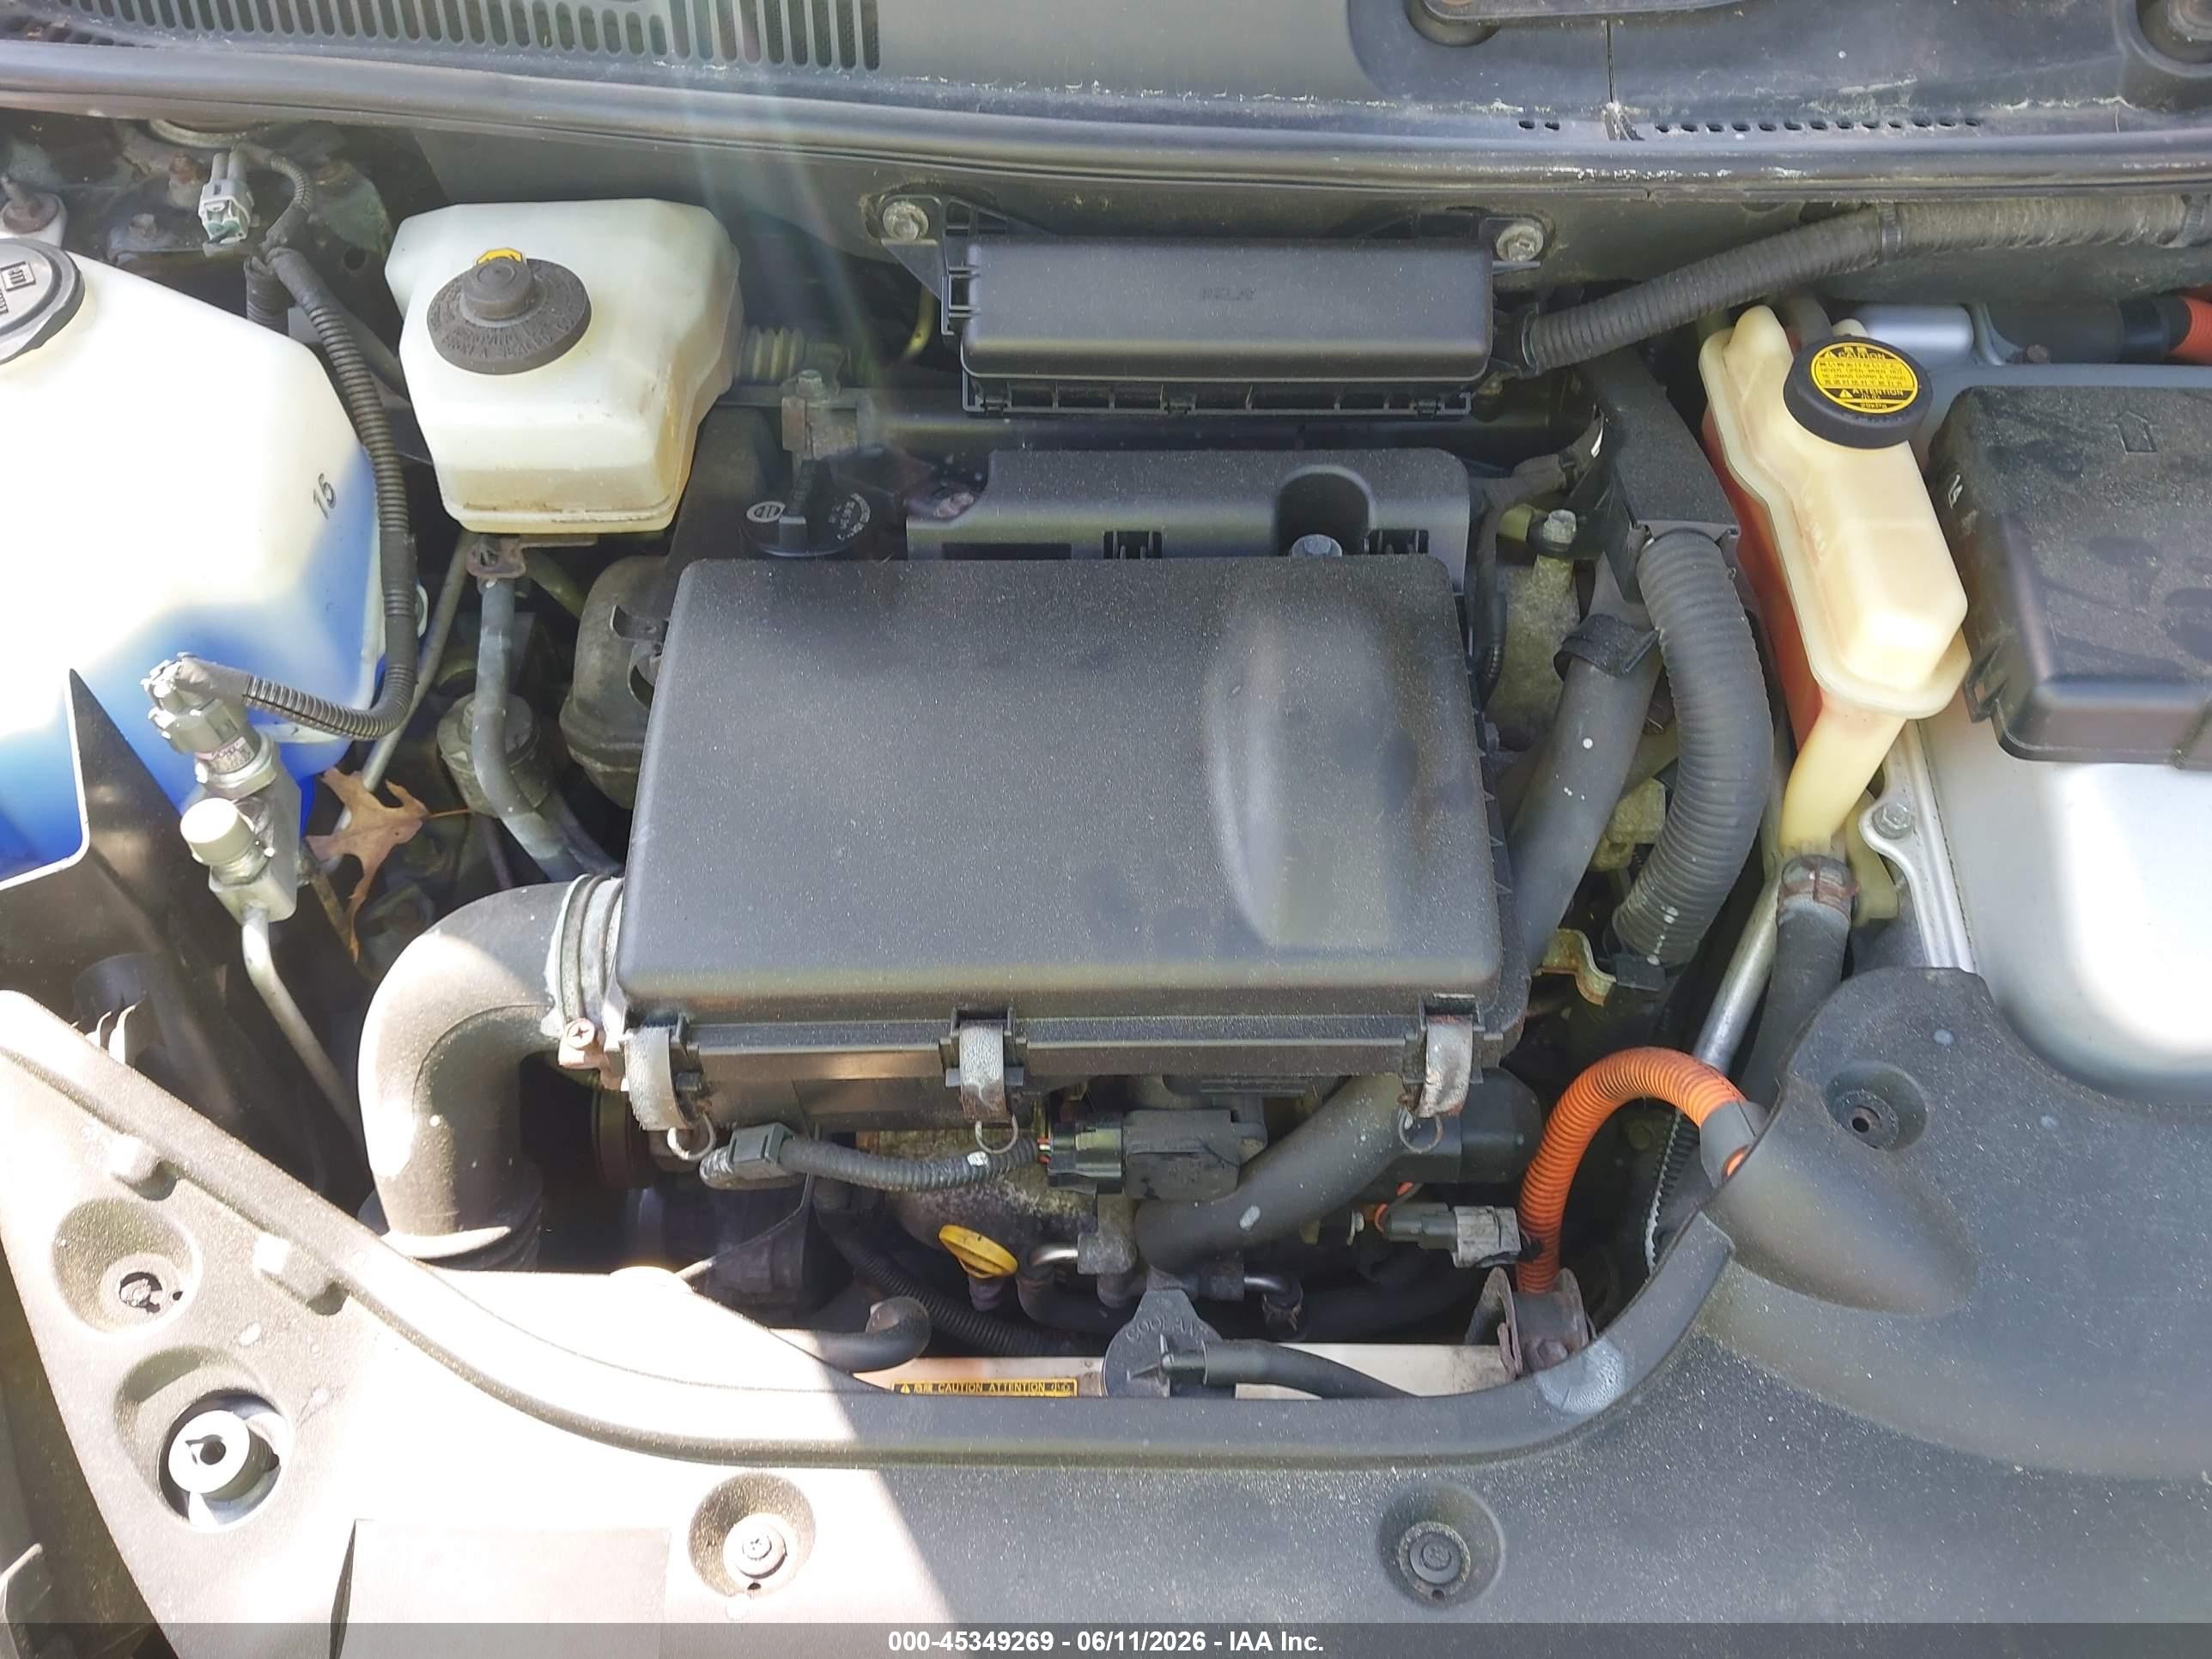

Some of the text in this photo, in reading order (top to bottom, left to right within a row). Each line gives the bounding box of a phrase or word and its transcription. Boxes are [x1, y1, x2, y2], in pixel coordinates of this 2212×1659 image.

[1838, 350, 1886, 361] CAUTION
[1853, 388, 1904, 397] ATTENTION
[938, 1382, 983, 1393] CAUTION
[988, 1382, 1045, 1393] ATTENTION
